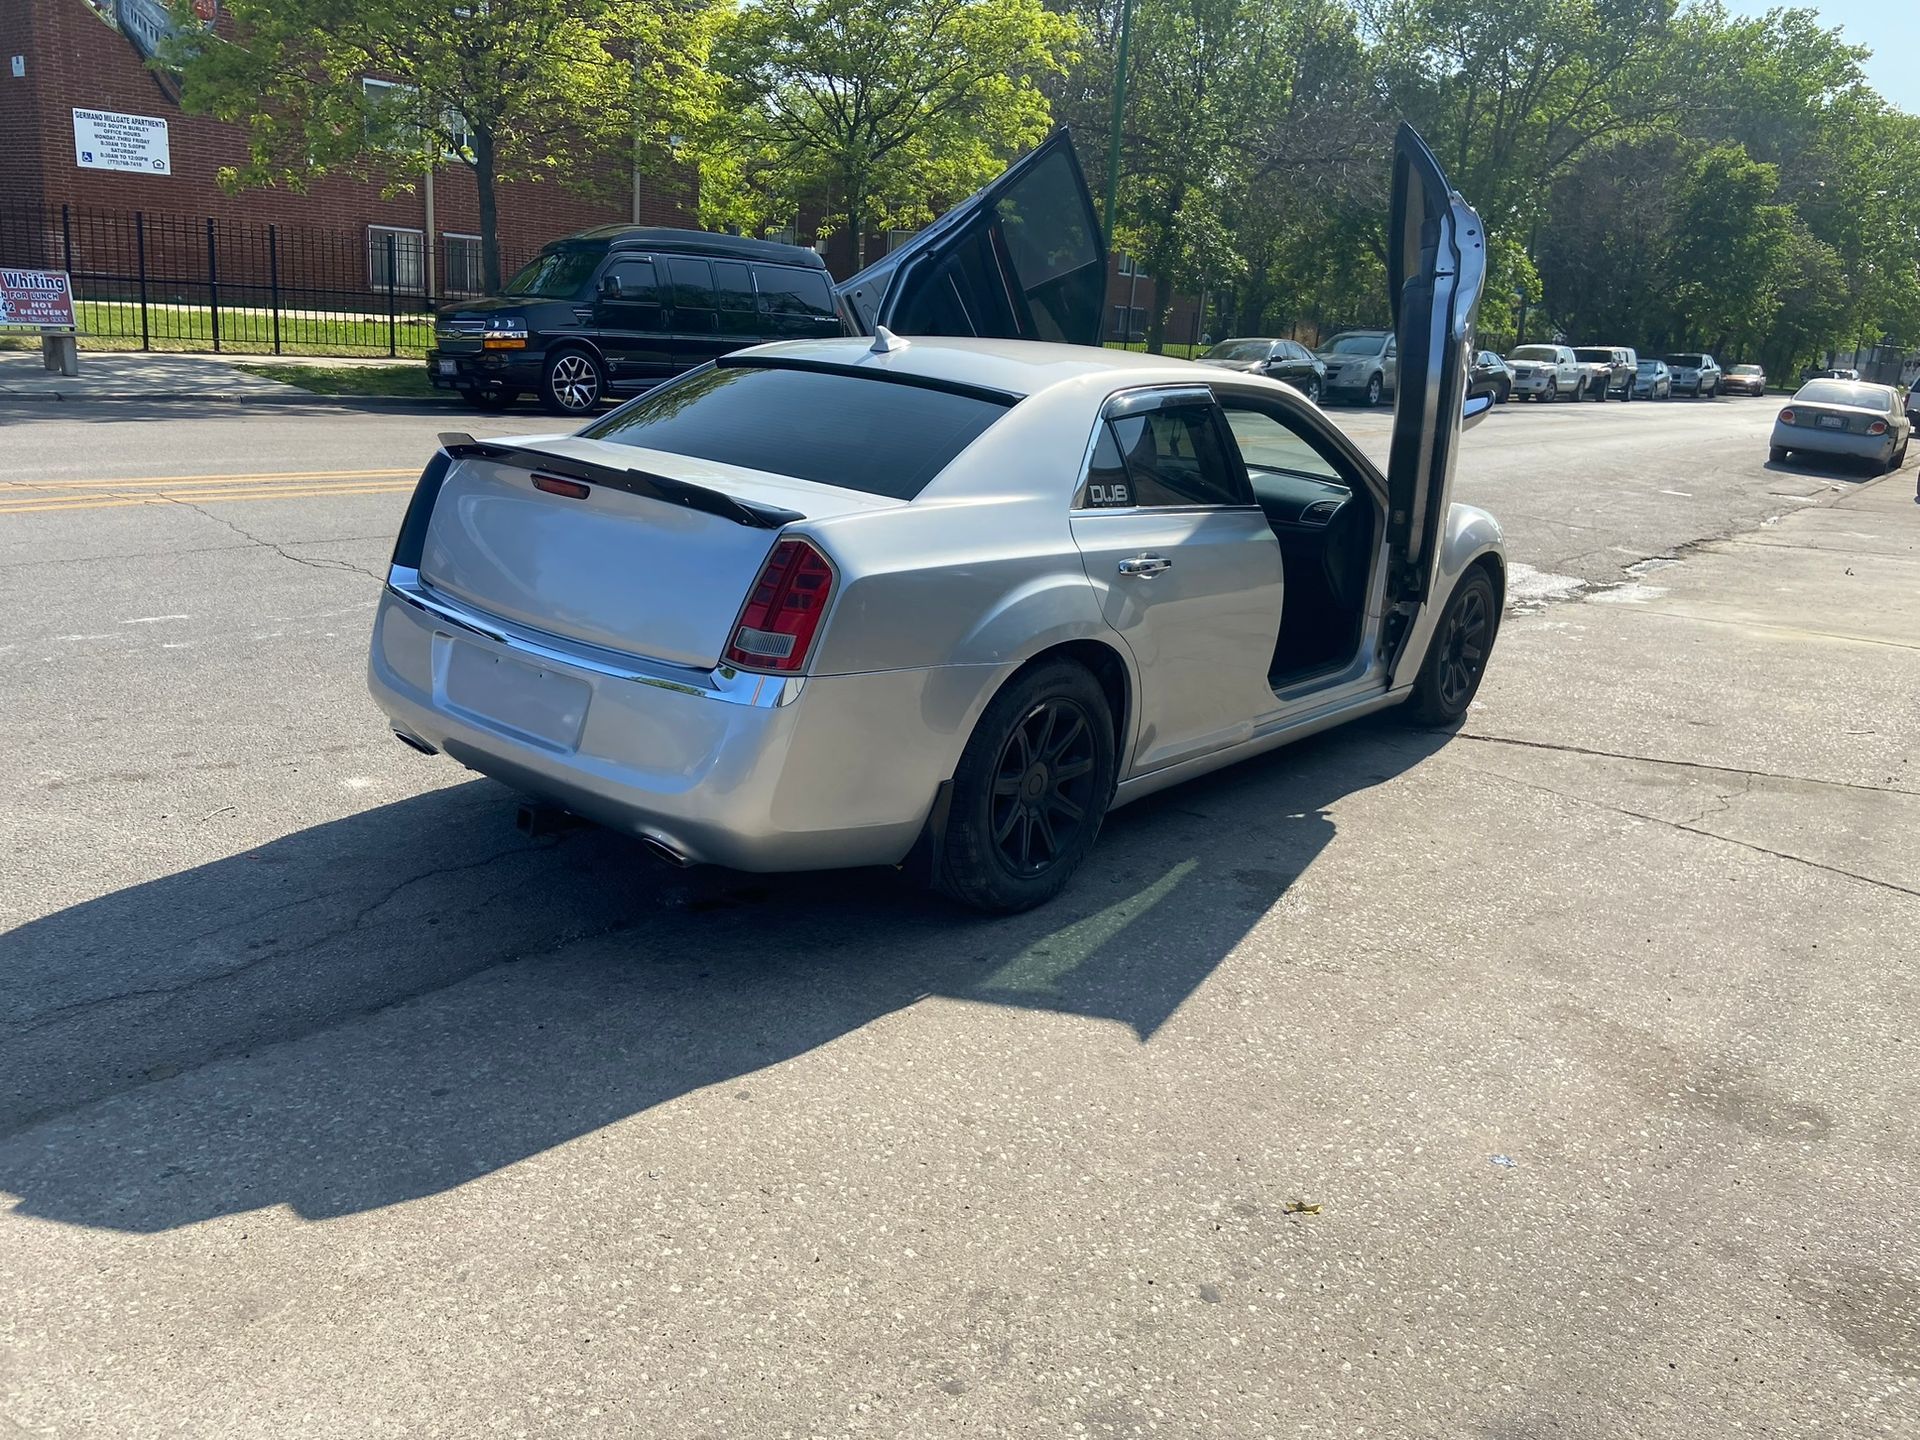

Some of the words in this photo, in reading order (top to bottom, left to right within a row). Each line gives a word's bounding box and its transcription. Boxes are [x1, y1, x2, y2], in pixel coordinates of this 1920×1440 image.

[75, 111, 103, 120] GERMANO
[103, 115, 130, 124] MILLGATE
[131, 118, 165, 128] APARTMENTS
[2, 272, 65, 292] Whiting
[10, 291, 28, 300] FOR
[31, 292, 59, 300] LUNCH
[1089, 485, 1127, 502] DUB
